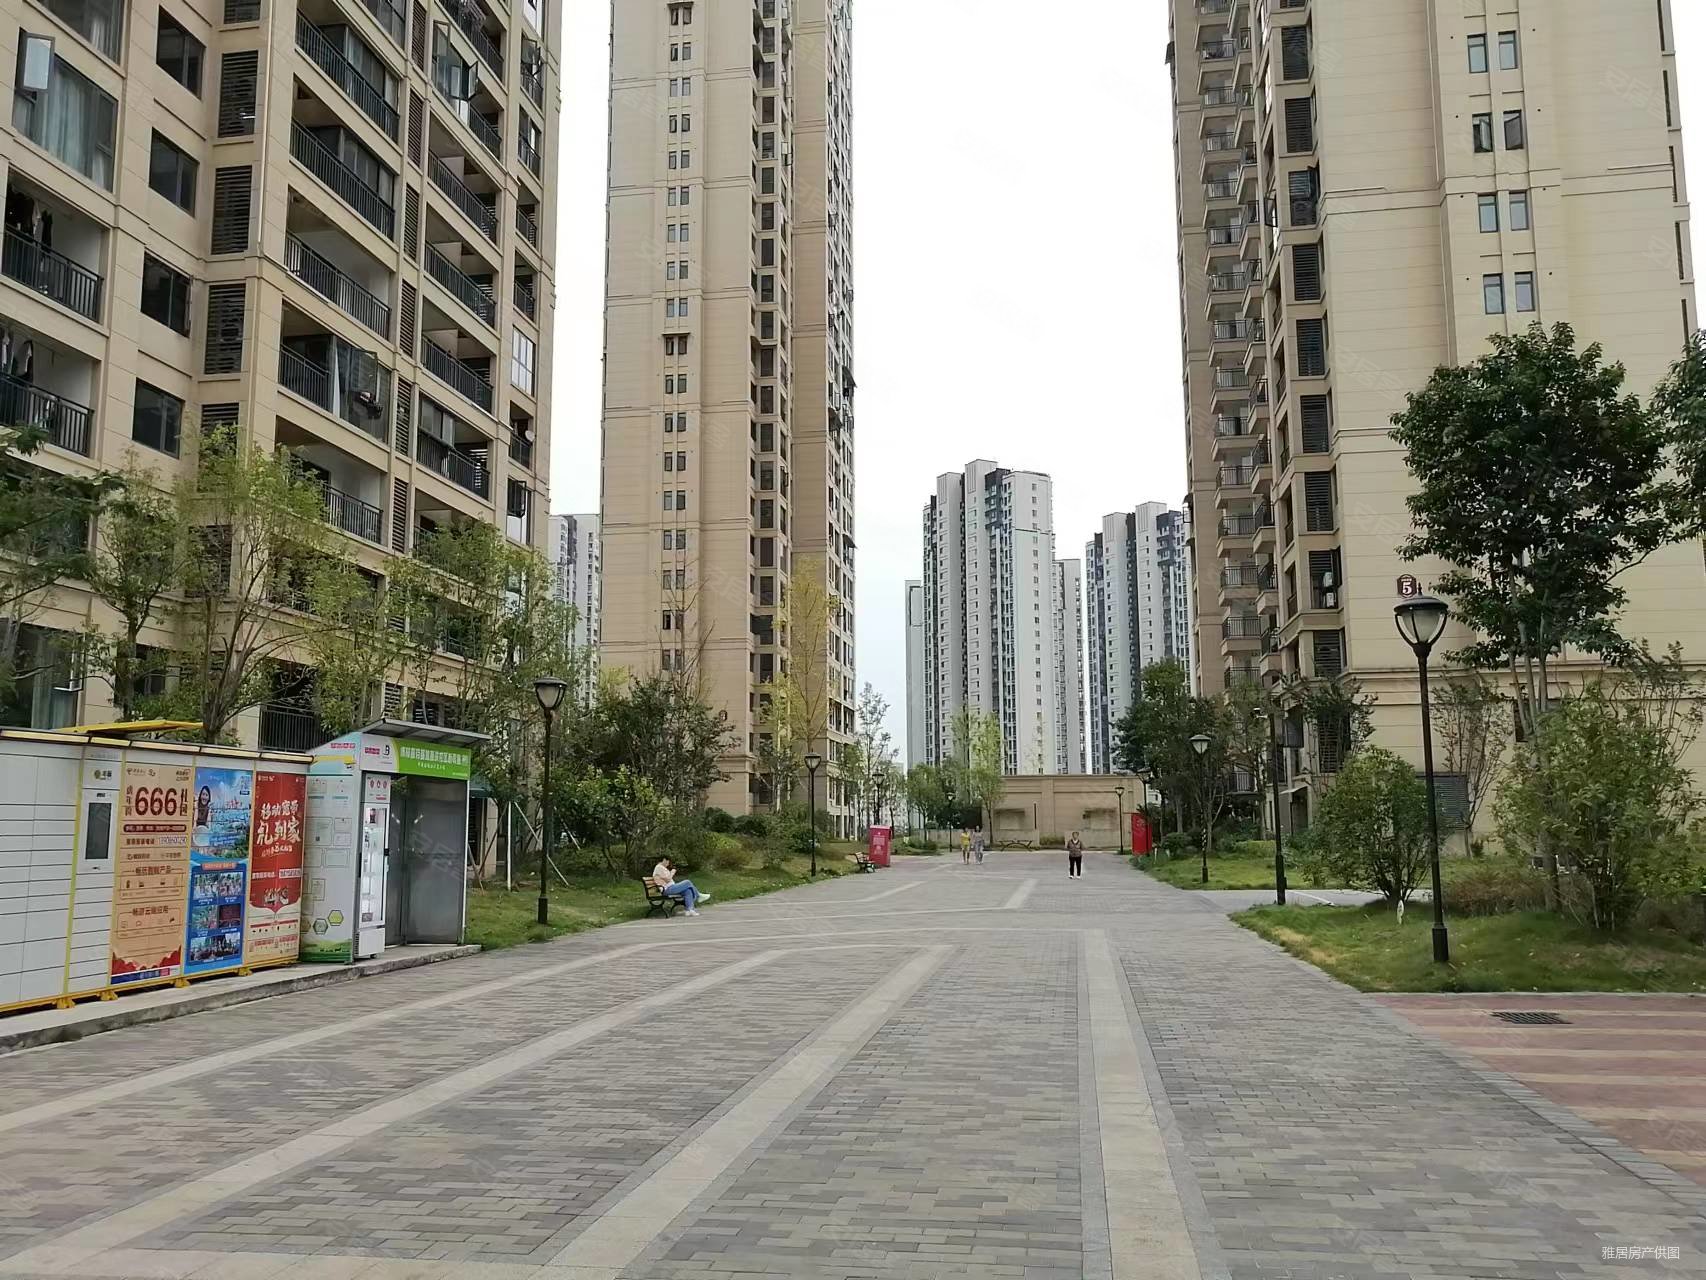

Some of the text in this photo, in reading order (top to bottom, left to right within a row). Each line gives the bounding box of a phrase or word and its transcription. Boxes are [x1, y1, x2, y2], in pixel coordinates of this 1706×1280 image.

[1402, 581, 1412, 595] 5
[135, 786, 178, 816] 666
[261, 799, 299, 820] 移动宽带
